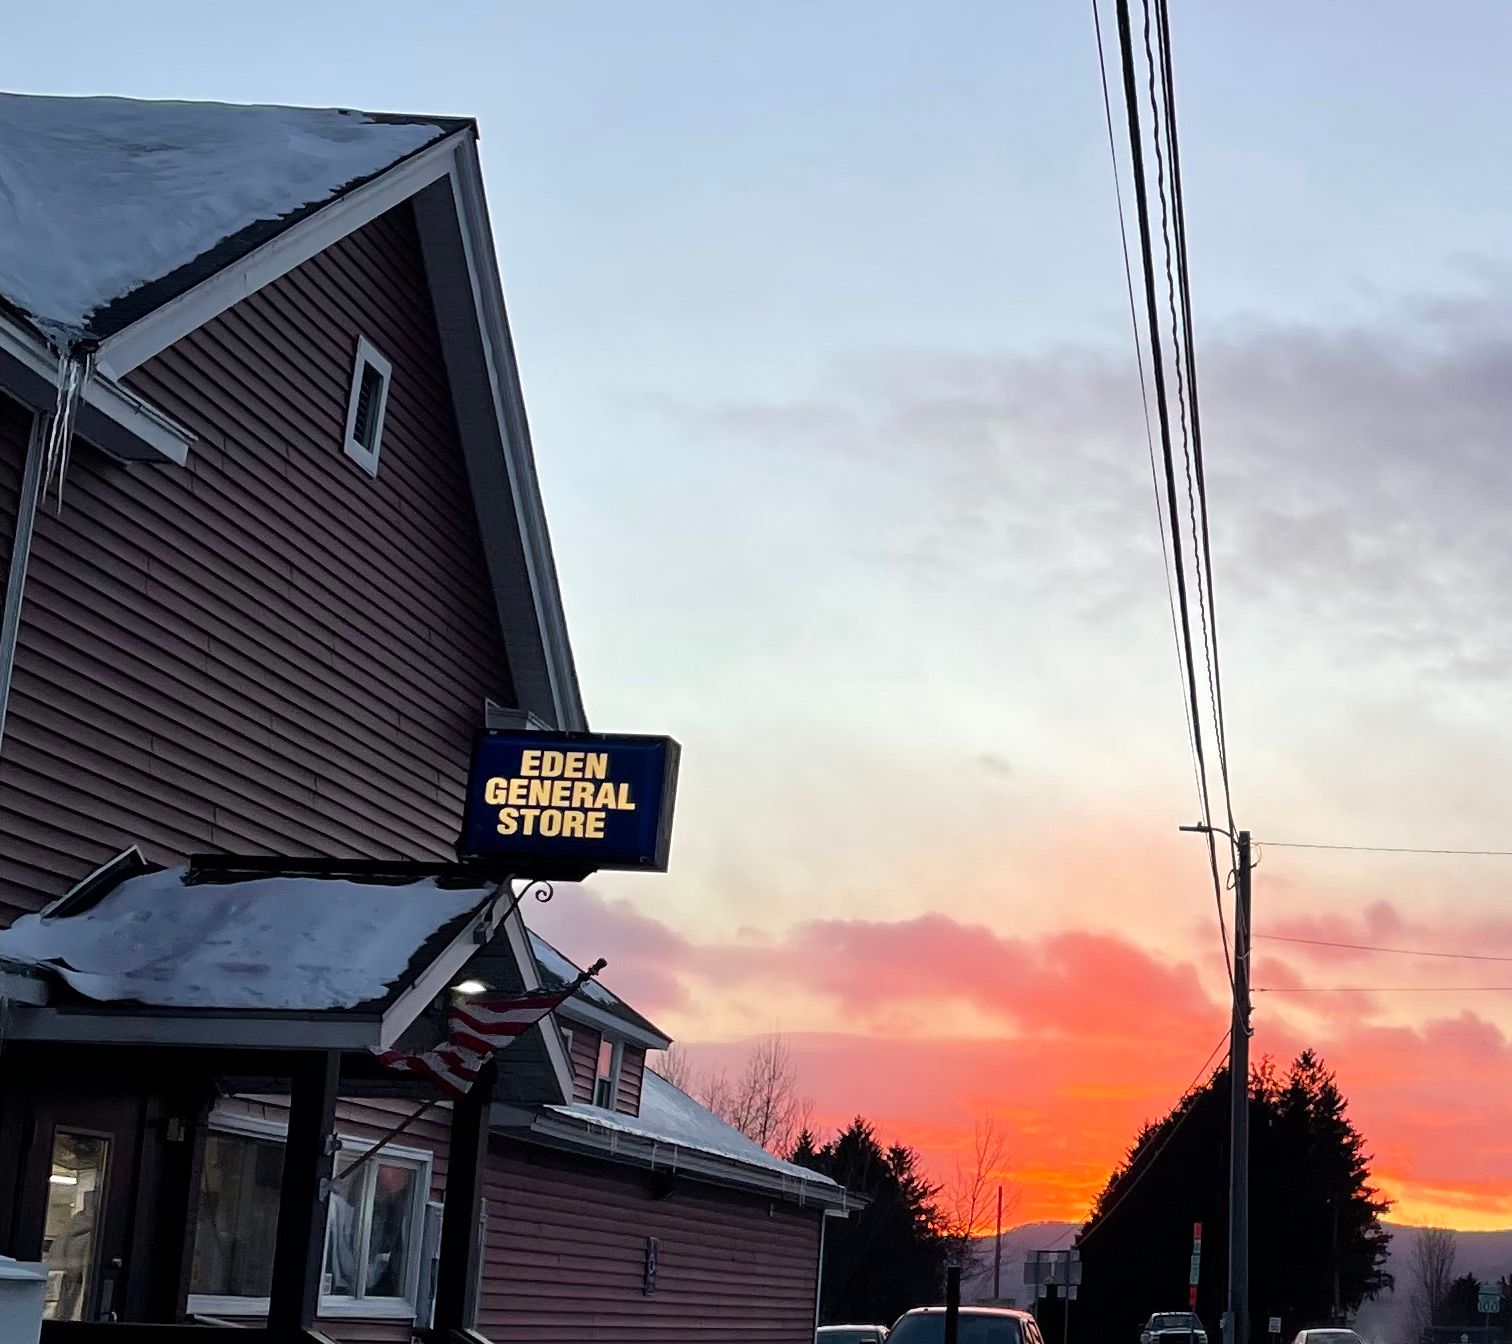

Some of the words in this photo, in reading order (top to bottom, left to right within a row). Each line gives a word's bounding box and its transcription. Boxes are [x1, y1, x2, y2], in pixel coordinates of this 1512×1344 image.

[520, 749, 609, 779] EDEN
[484, 777, 636, 811] GENERAL
[496, 807, 607, 839] STORE
